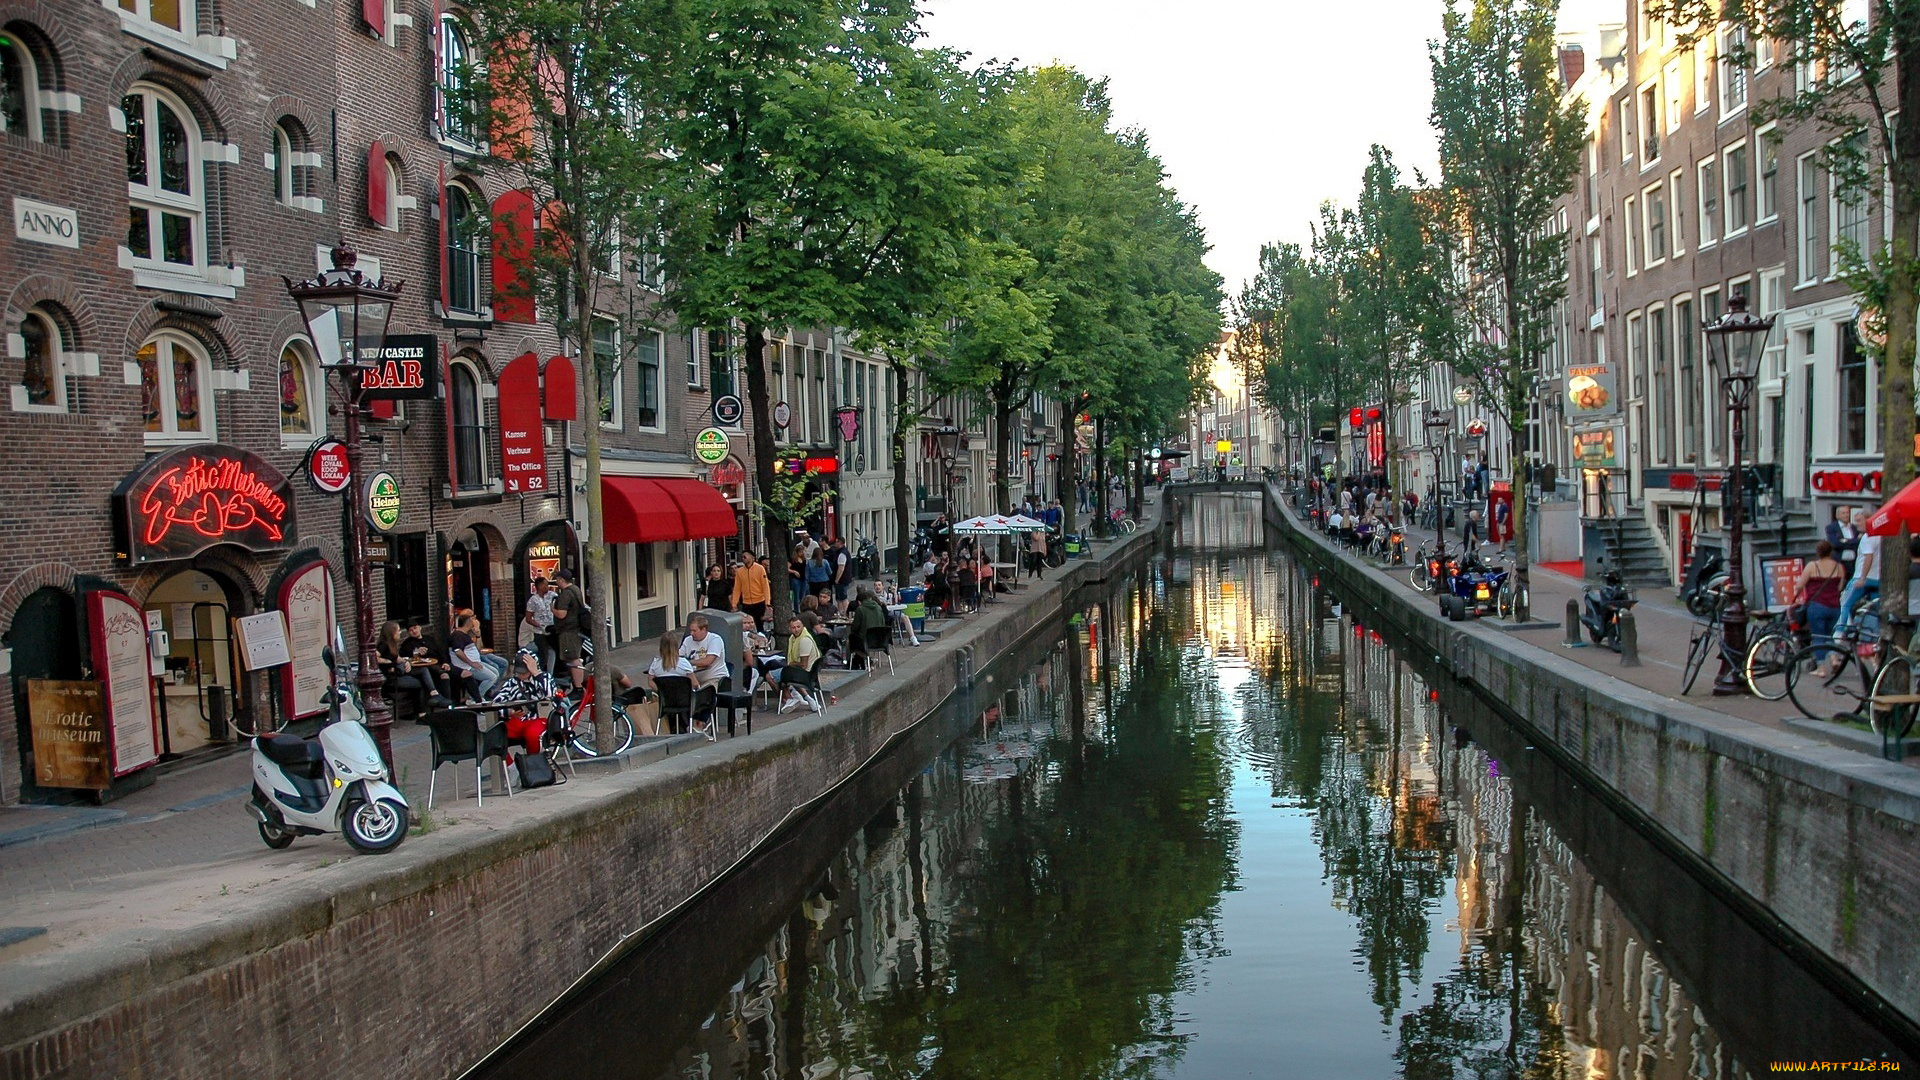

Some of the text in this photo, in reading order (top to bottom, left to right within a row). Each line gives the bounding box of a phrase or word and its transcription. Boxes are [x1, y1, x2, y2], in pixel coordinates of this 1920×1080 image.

[21, 210, 73, 238] ANNO
[361, 359, 424, 389] BAR
[1569, 365, 1609, 377] FALAFEL
[508, 462, 541, 471] The Office
[528, 476, 543, 489] 52
[141, 456, 288, 546] Erotic Museum
[366, 547, 387, 556] SEUM
[45, 708, 93, 727] Erotic
[38, 727, 101, 743] museum
[44, 764, 53, 781] 5
